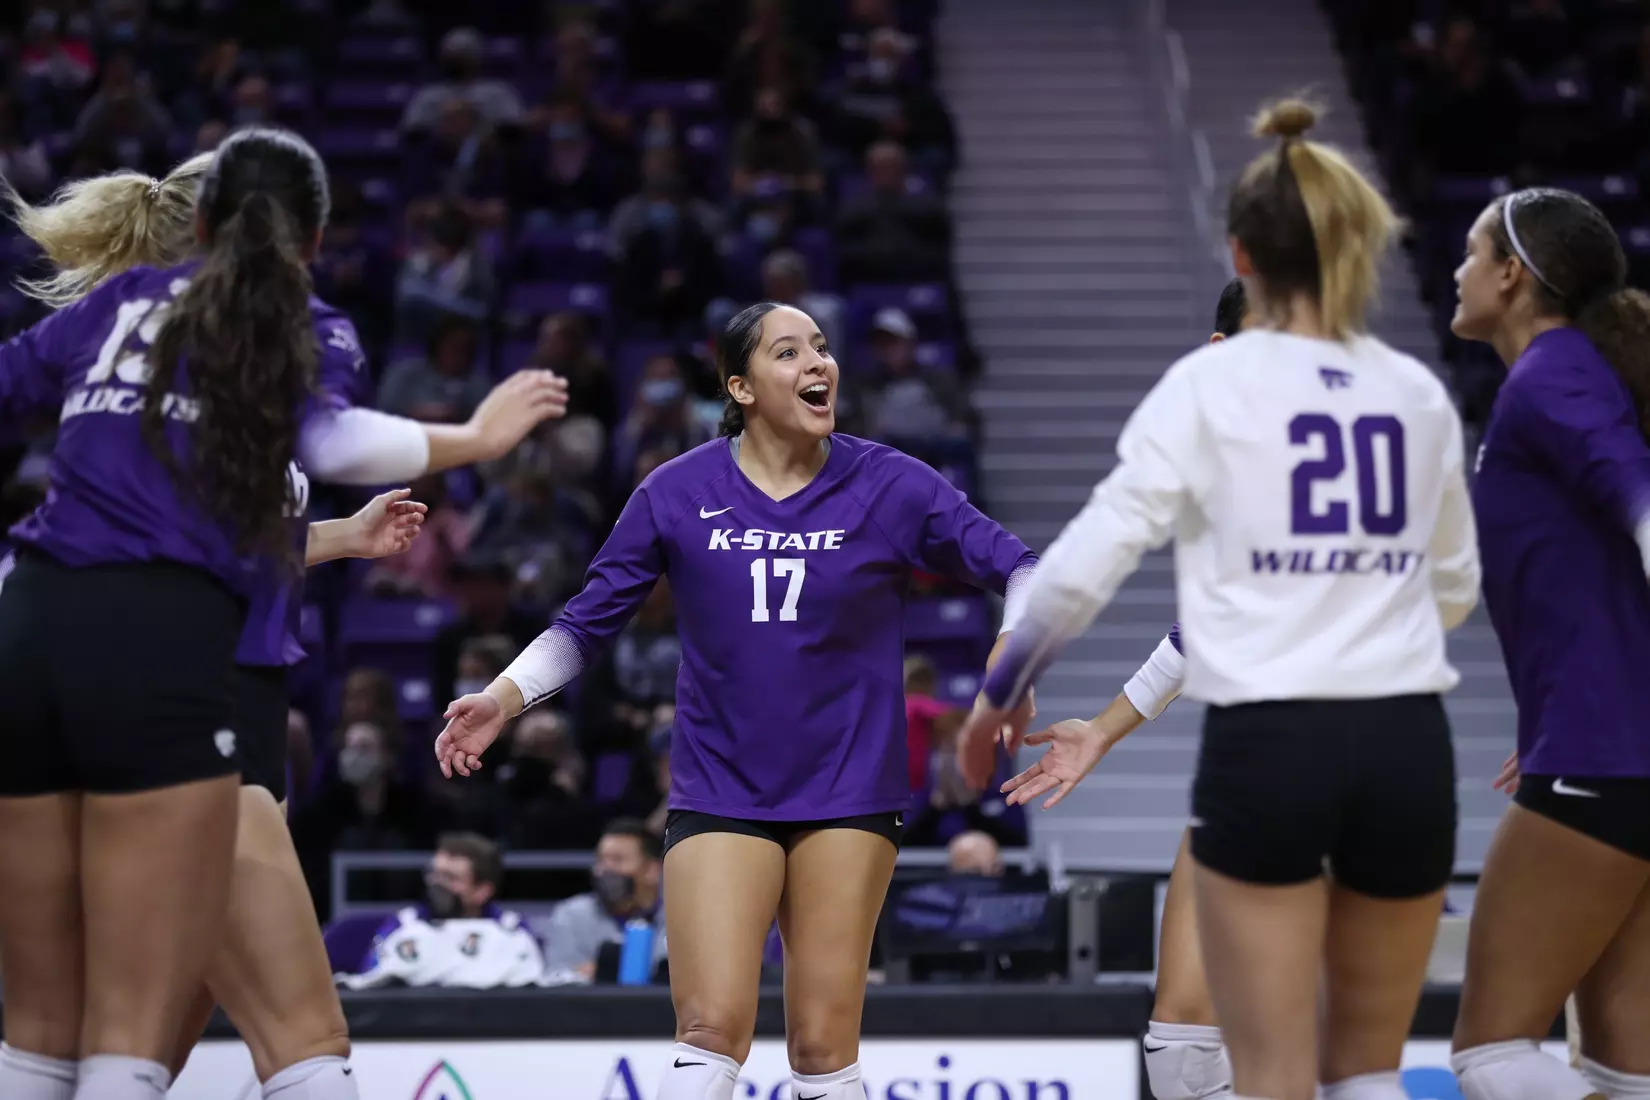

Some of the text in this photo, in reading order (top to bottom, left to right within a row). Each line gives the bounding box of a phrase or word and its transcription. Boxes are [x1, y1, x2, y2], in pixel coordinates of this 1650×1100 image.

[1288, 412, 1407, 537] 20
[708, 528, 846, 551] K-STATE
[1251, 548, 1425, 575] WILDCAT
[750, 558, 806, 622] 17
[601, 1055, 1071, 1100] Asion
